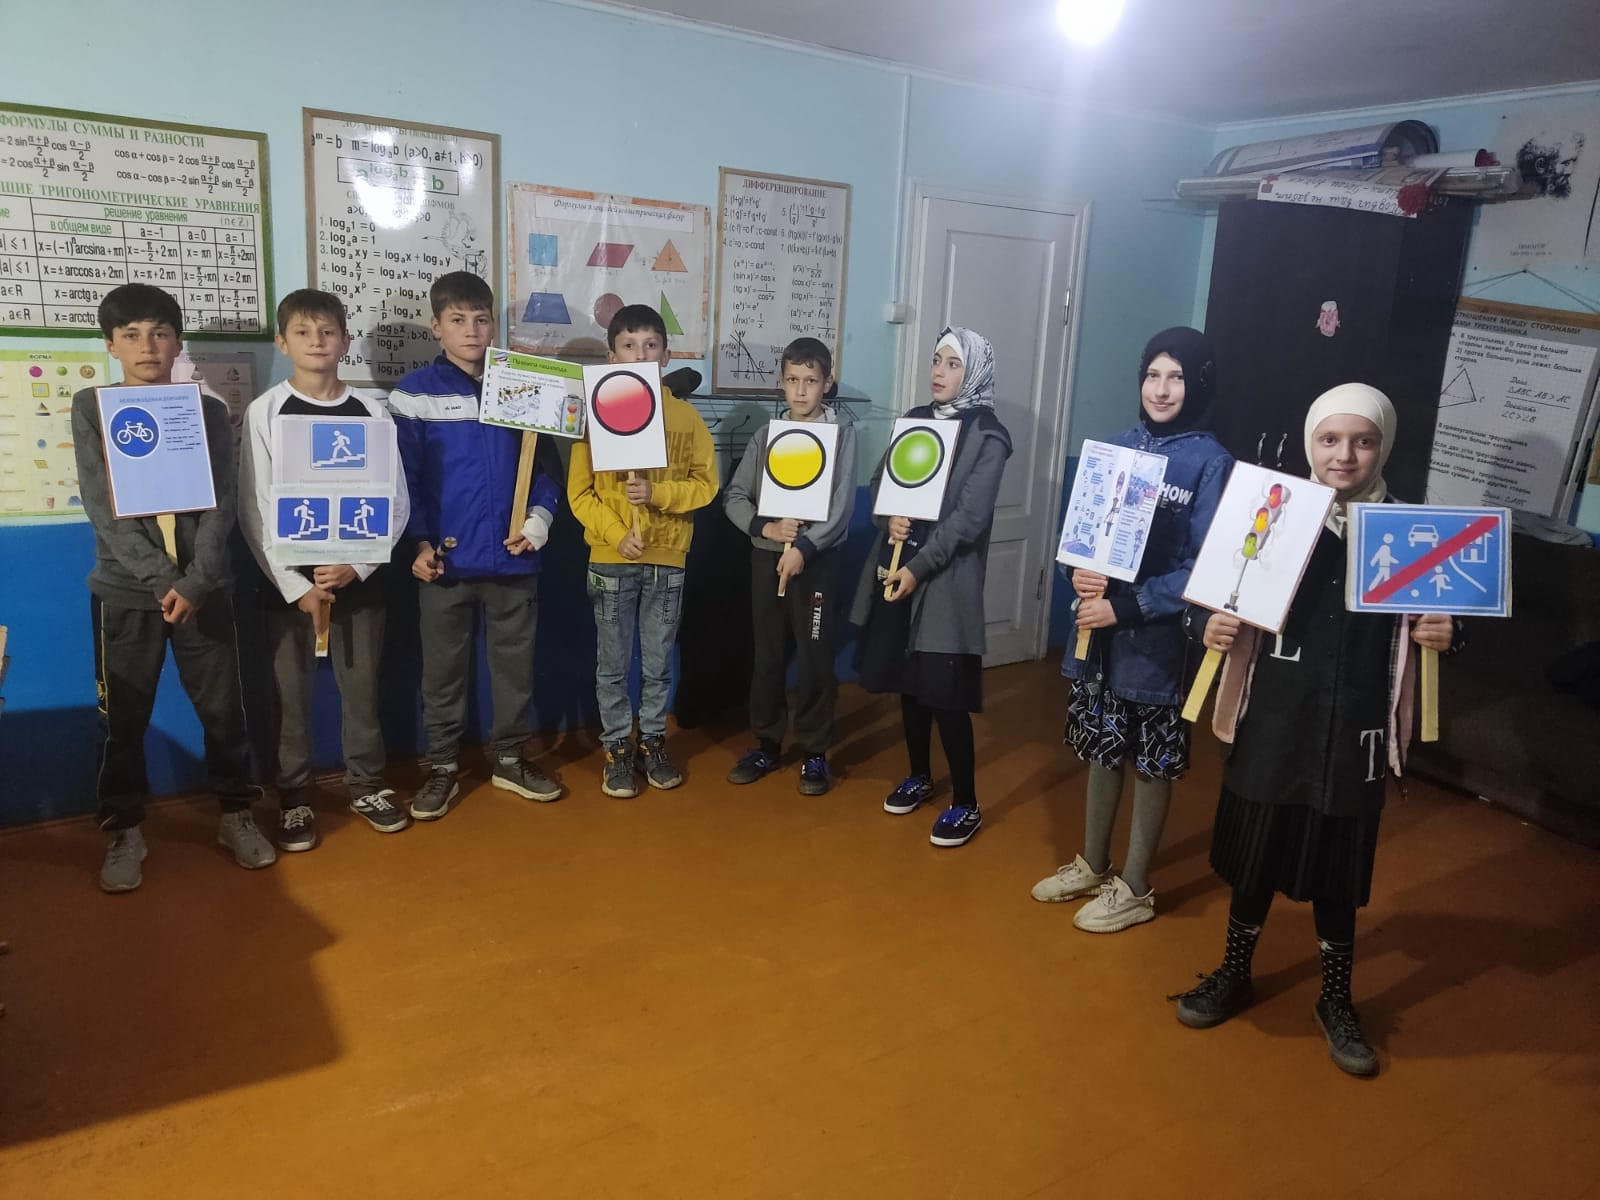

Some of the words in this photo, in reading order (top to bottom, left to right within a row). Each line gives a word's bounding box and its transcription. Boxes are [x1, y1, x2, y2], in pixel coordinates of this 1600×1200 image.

[0, 113, 67, 132] ФОРМУЛЫ
[73, 122, 125, 139] СУММЫ
[130, 129, 139, 140] И
[144, 131, 205, 148] РАЗНОСТИ
[40, 184, 188, 208] ТРИГОНОМЕТРИЧЕСКИЕ
[195, 198, 260, 214] УРАВНЕНИЯ
[58, 219, 88, 234] общем
[90, 224, 112, 234] виде
[104, 207, 143, 220] решение
[145, 208, 188, 222] уравнения
[1500, 317, 1527, 327] МЕЖДУ
[1530, 322, 1581, 335] СТОРОНАМИ
[810, 591, 824, 641] EXTREME
